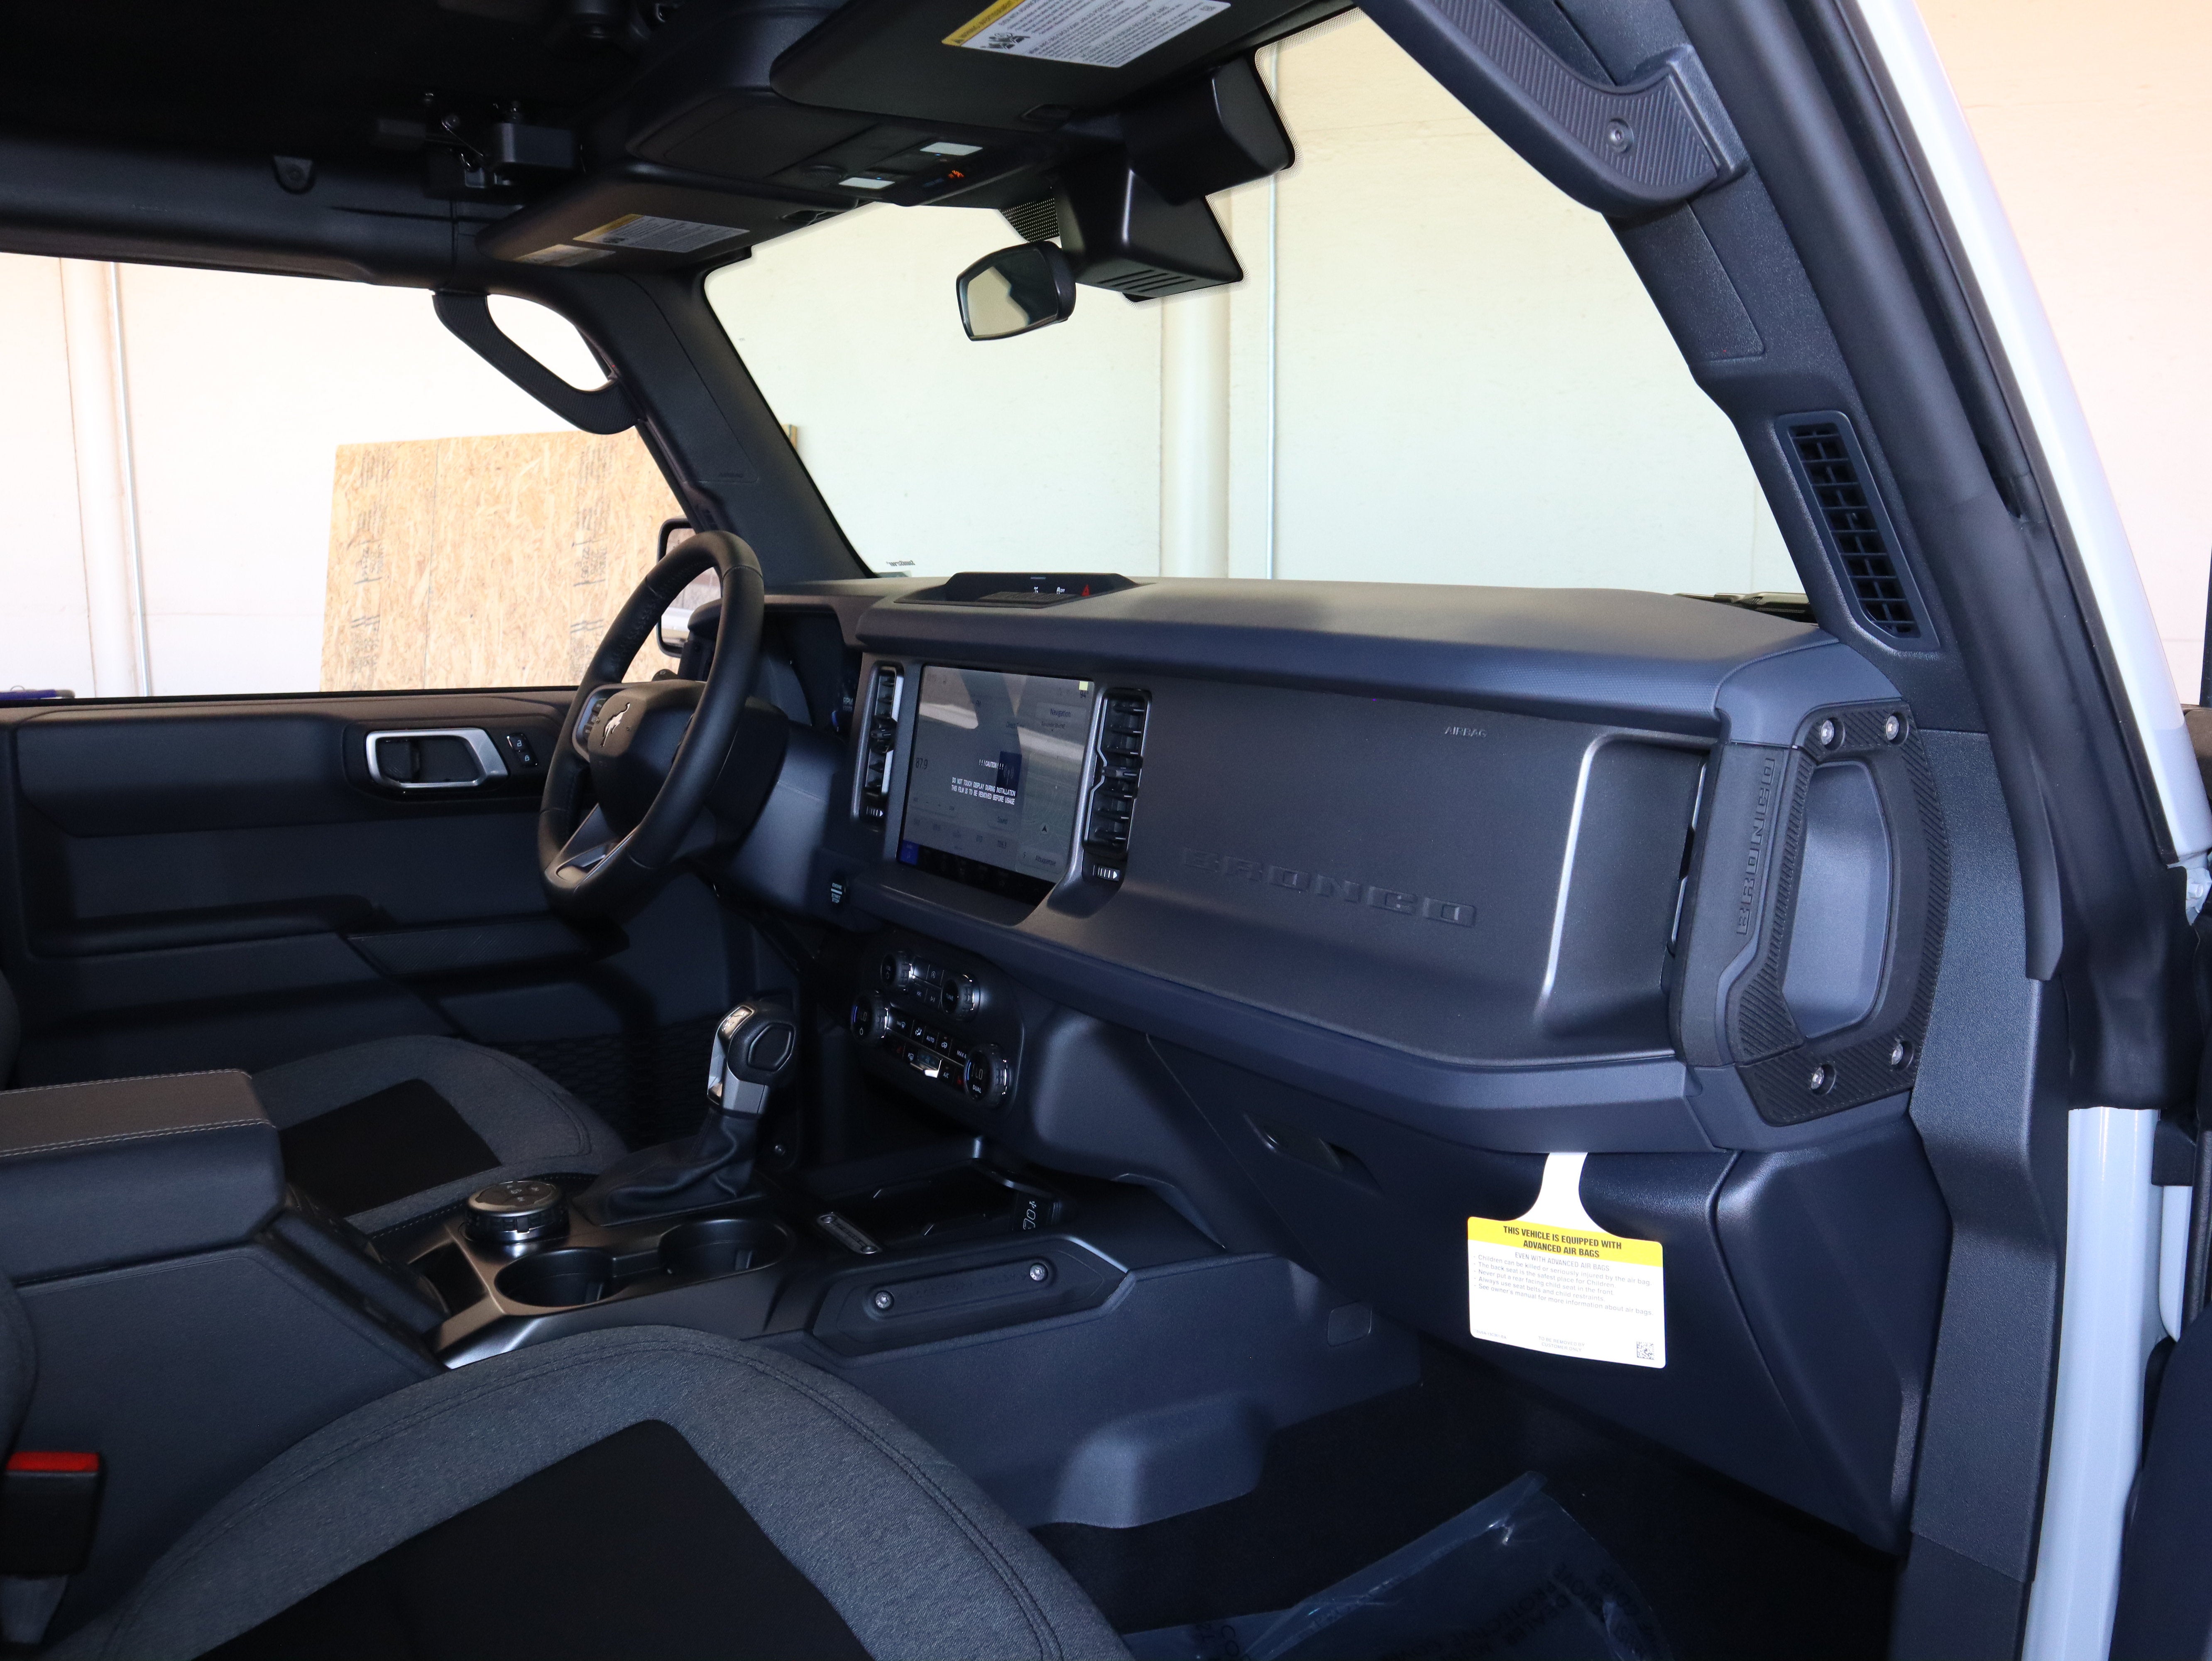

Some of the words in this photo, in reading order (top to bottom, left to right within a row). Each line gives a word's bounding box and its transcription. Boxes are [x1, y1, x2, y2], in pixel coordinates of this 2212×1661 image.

[1050, 708, 1071, 718] Navigation
[1444, 726, 1487, 738] AIRBAG
[915, 757, 928, 770] 87.9
[973, 781, 984, 790] DISPLAY
[985, 784, 996, 793] DURING
[996, 786, 1016, 797] INSTALLATION
[978, 791, 992, 799] REMOVED
[992, 794, 1005, 803] BEFORE
[1005, 797, 1015, 805] USAGE
[1737, 757, 1776, 936] BRONCO
[1182, 846, 1477, 928] BRONCO
[972, 1084, 981, 1094] DUAL
[1503, 1225, 1520, 1235] THIS
[1522, 1229, 1550, 1240] VEHICLE
[1561, 1235, 1599, 1247] EQUIPPED
[1601, 1240, 1622, 1250] WITH
[1523, 1240, 1561, 1253] ADVANCED
[1564, 1246, 1577, 1255] AIR
[1578, 1248, 1600, 1258] BAGS
[1478, 1254, 1503, 1265] Children
[1550, 1267, 1579, 1278] seriously
[1581, 1271, 1604, 1281] injured
[1637, 1278, 1652, 1287] bag.
[1531, 1254, 1546, 1263] WITH
[1547, 1257, 1579, 1268] ADVANCED
[1478, 1269, 1495, 1278] Never
[1525, 1277, 1544, 1287] facing
[1545, 1281, 1561, 1289] child
[1597, 1288, 1615, 1296] front.
[1491, 1263, 1505, 1271] back
[1537, 1271, 1555, 1280] safest
[1557, 1274, 1574, 1283] place
[1586, 1279, 1617, 1289] Children.
[1478, 1276, 1498, 1287] Always
[1526, 1283, 1541, 1292] belts
[1555, 1288, 1571, 1296] child
[1573, 1291, 1605, 1302] restraints.
[1491, 1286, 1514, 1295] owner's
[1515, 1290, 1537, 1299] manual
[1566, 1298, 1603, 1309] information
[1605, 1303, 1623, 1312] about
[1635, 1308, 1654, 1317] bags.
[1541, 1342, 1568, 1350] CUSTOMER
[1502, 1594, 1571, 1647] DEALER
